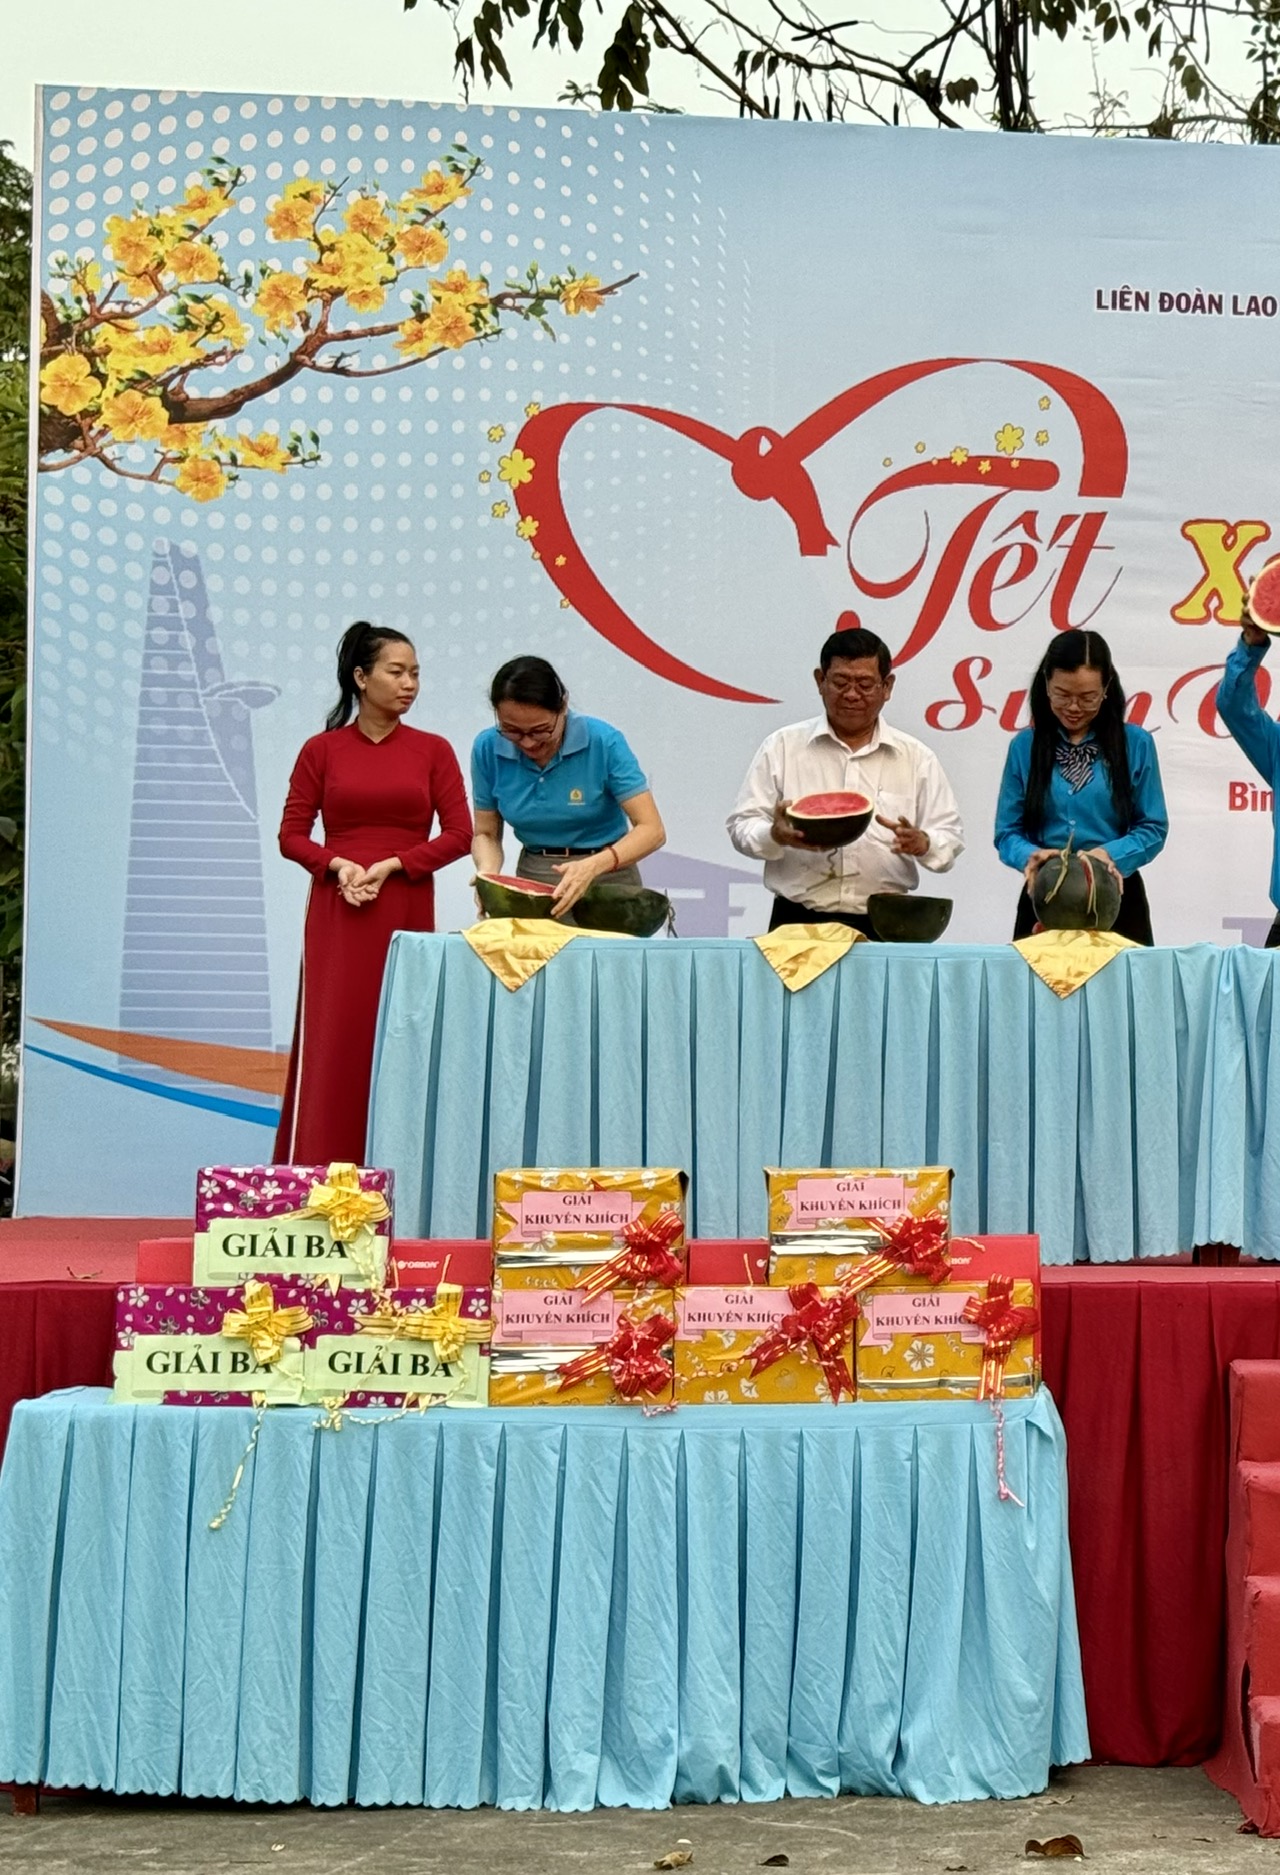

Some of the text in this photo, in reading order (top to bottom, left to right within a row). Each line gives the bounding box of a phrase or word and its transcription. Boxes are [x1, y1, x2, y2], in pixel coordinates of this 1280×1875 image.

[1096, 284, 1150, 312] LIÊN
[1158, 287, 1223, 315] ĐOÀN
[1232, 294, 1278, 318] LAO
[847, 459, 1124, 670] Tết
[1228, 781, 1274, 812] Bìn
[836, 1179, 865, 1192] GIẢI
[562, 1193, 592, 1206] GIẢI
[800, 1197, 901, 1211] KHUYẾN KHÍCH
[525, 1211, 629, 1225] KHUYẾN KHÍCH
[222, 1227, 349, 1259] GIẢI BA
[543, 1293, 573, 1306] GIẢI
[725, 1291, 754, 1305] GIẢI
[912, 1294, 940, 1308] GIẢI
[506, 1311, 610, 1324] KHUYẾN KHÍCH
[687, 1310, 785, 1323] KHUYẾN KHÍC
[876, 1313, 931, 1327] KHUYẾN
[146, 1344, 221, 1374] GIẢI
[328, 1345, 454, 1378] GIẢI BA
